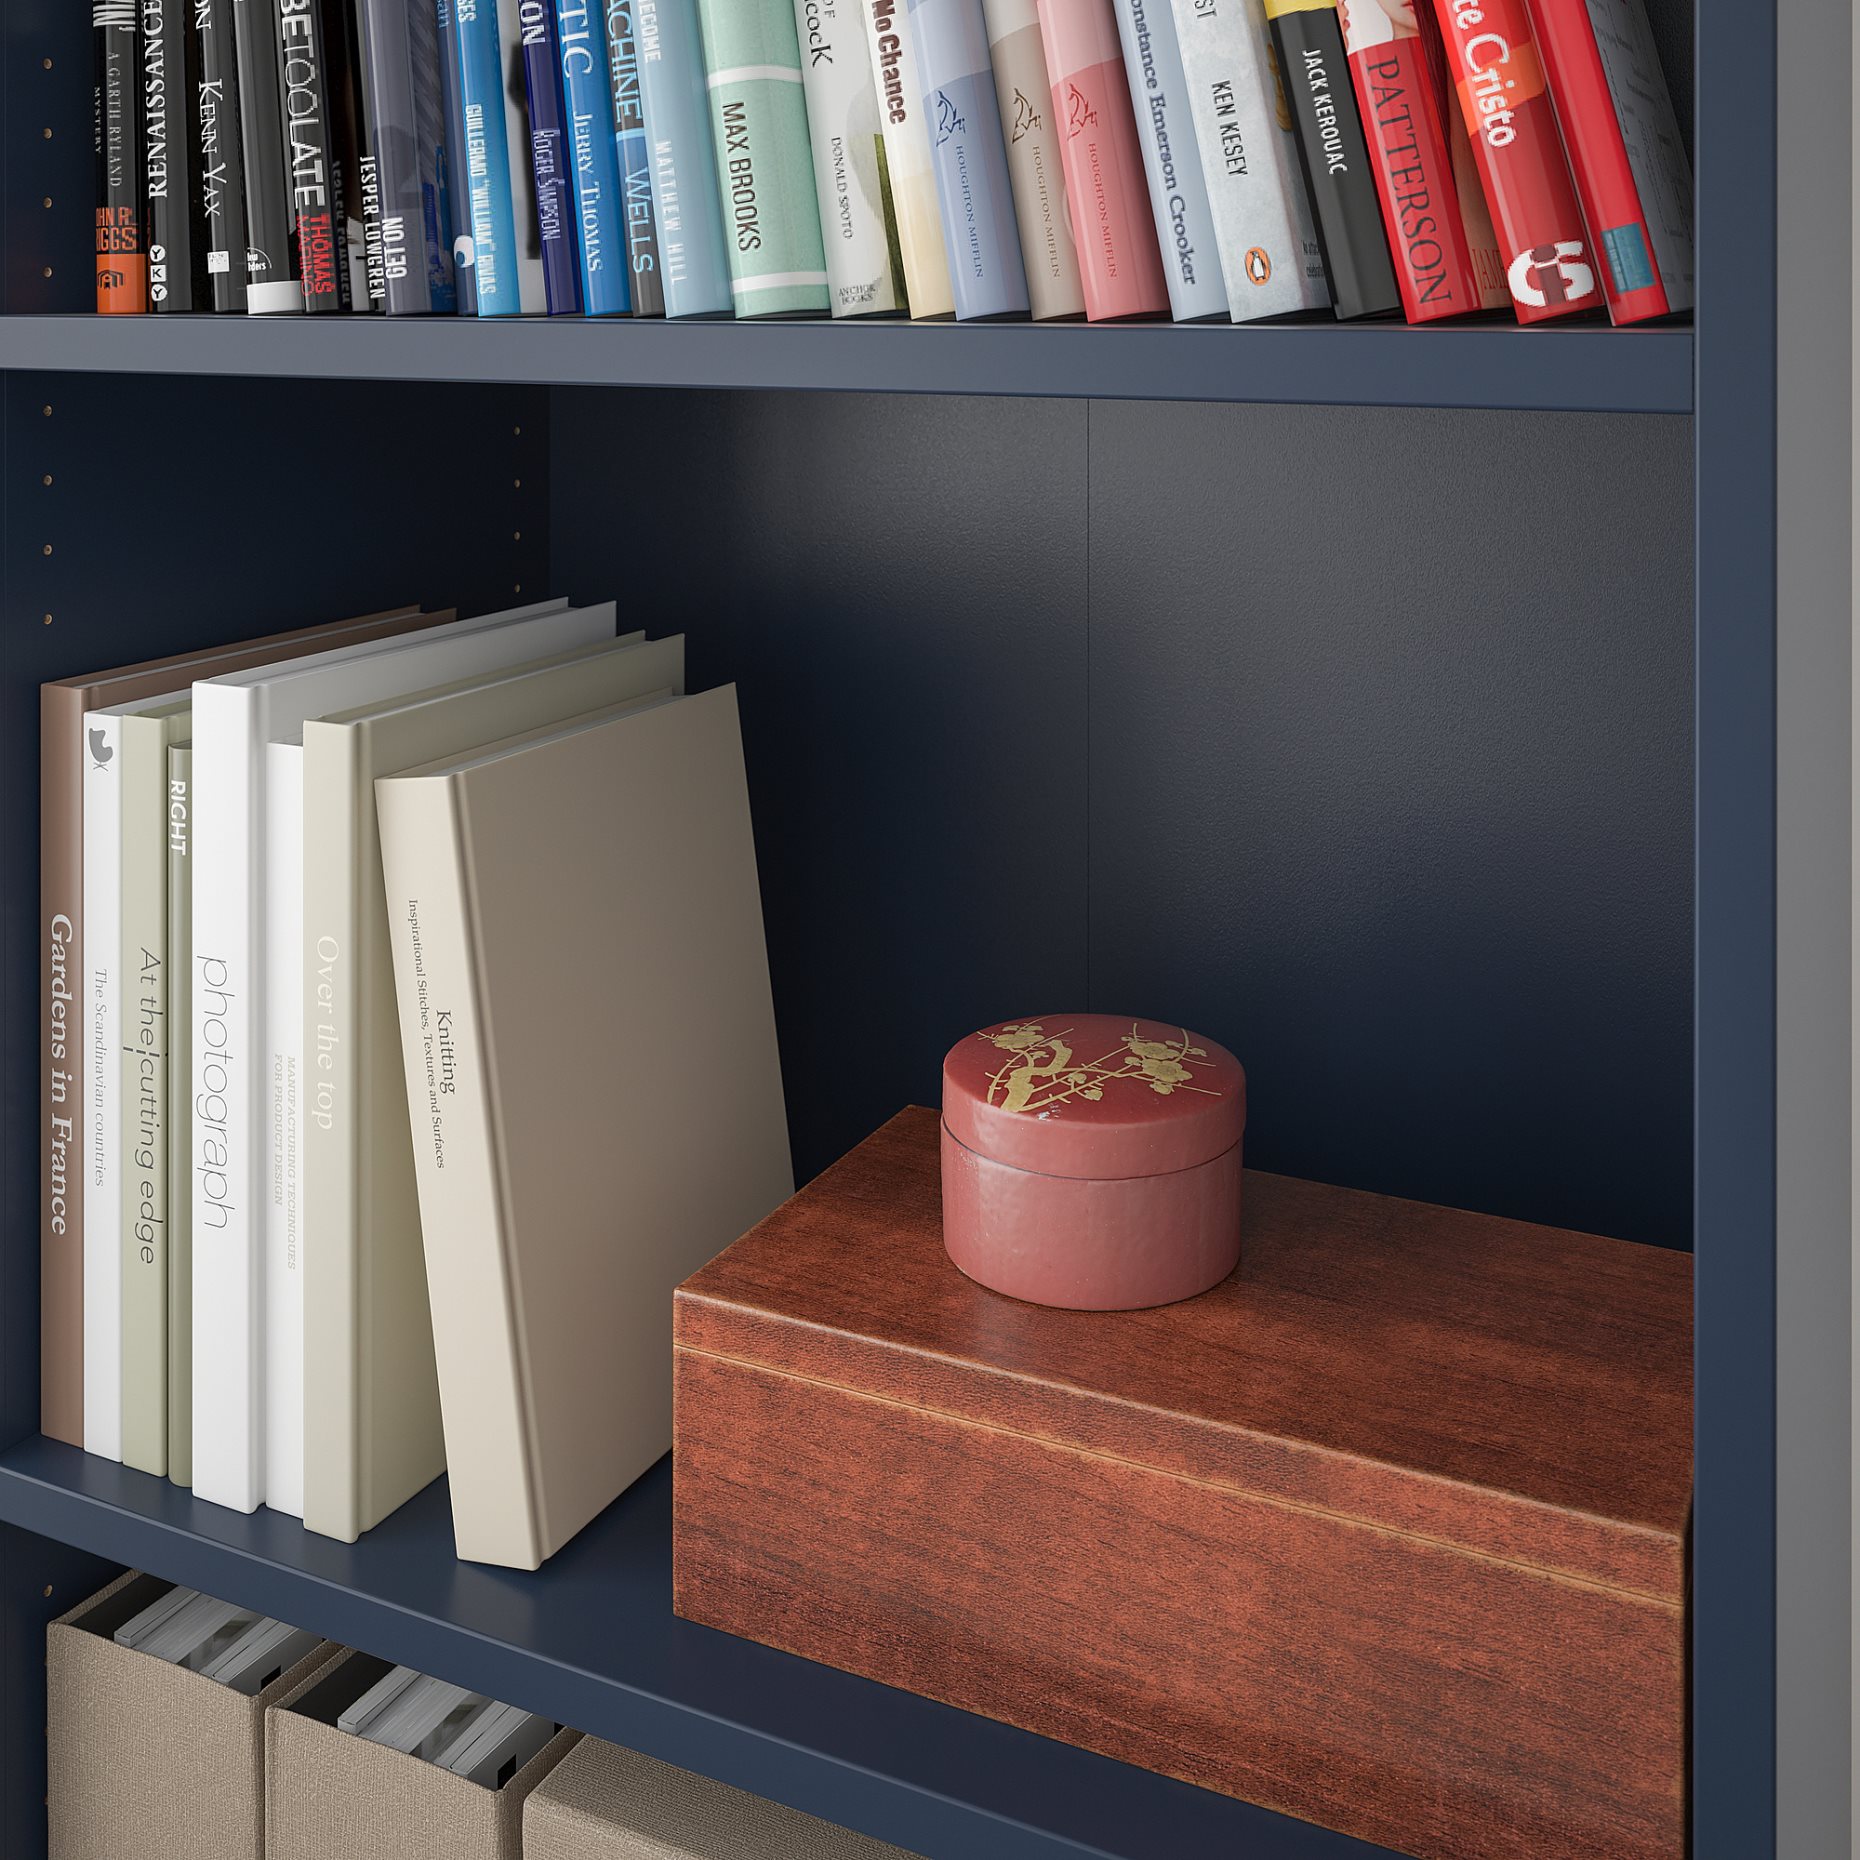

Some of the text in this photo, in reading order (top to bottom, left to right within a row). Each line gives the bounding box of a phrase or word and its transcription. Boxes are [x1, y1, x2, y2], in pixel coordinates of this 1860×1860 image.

[107, 67, 121, 119] GARTH
[465, 103, 488, 177] GUILLERMO
[572, 112, 595, 175] JERRY
[878, 33, 907, 125] Chance
[1211, 79, 1236, 119] KEN
[1302, 48, 1348, 176] JACK KEROUAC
[1465, 32, 1517, 149] Cristo
[109, 126, 123, 187] RYLAND
[537, 176, 566, 241] SIMPSON
[655, 139, 688, 287] MATTHEW HILL
[722, 101, 762, 252] MAX BROOKS
[831, 136, 854, 240] DONALD SPOTO
[955, 145, 983, 278] HOUGHTON MIFFLIN
[1032, 145, 1061, 278] HOUGHTON MIFFLIN
[1088, 143, 1117, 278] HOUGHTON MIFFLIN
[1150, 92, 1177, 191] Emerson
[1169, 194, 1196, 286] Crooker
[1219, 121, 1249, 178] KESEY
[1366, 55, 1453, 306] PATTERSON
[309, 212, 337, 294] THOMAS
[360, 156, 386, 299] JESPER LOWGREN
[580, 181, 604, 273] THOMAS
[624, 166, 655, 274] WELLS
[170, 779, 187, 856] RIGHT
[50, 913, 73, 1237] Gardens in France
[95, 967, 108, 1188] The Scandinavian countries
[196, 954, 236, 1230] photograph
[311, 935, 340, 1131] Over the top
[407, 899, 445, 1169] Inspirational Stitches, Textures and Surfaces
[436, 1009, 457, 1095] Knitting
[135, 946, 164, 1265] At the cutting edge
[274, 1053, 284, 1207] FOR PRODUCT DESIGN
[287, 1055, 297, 1271] MANUFACTURING TECHNIQUES
